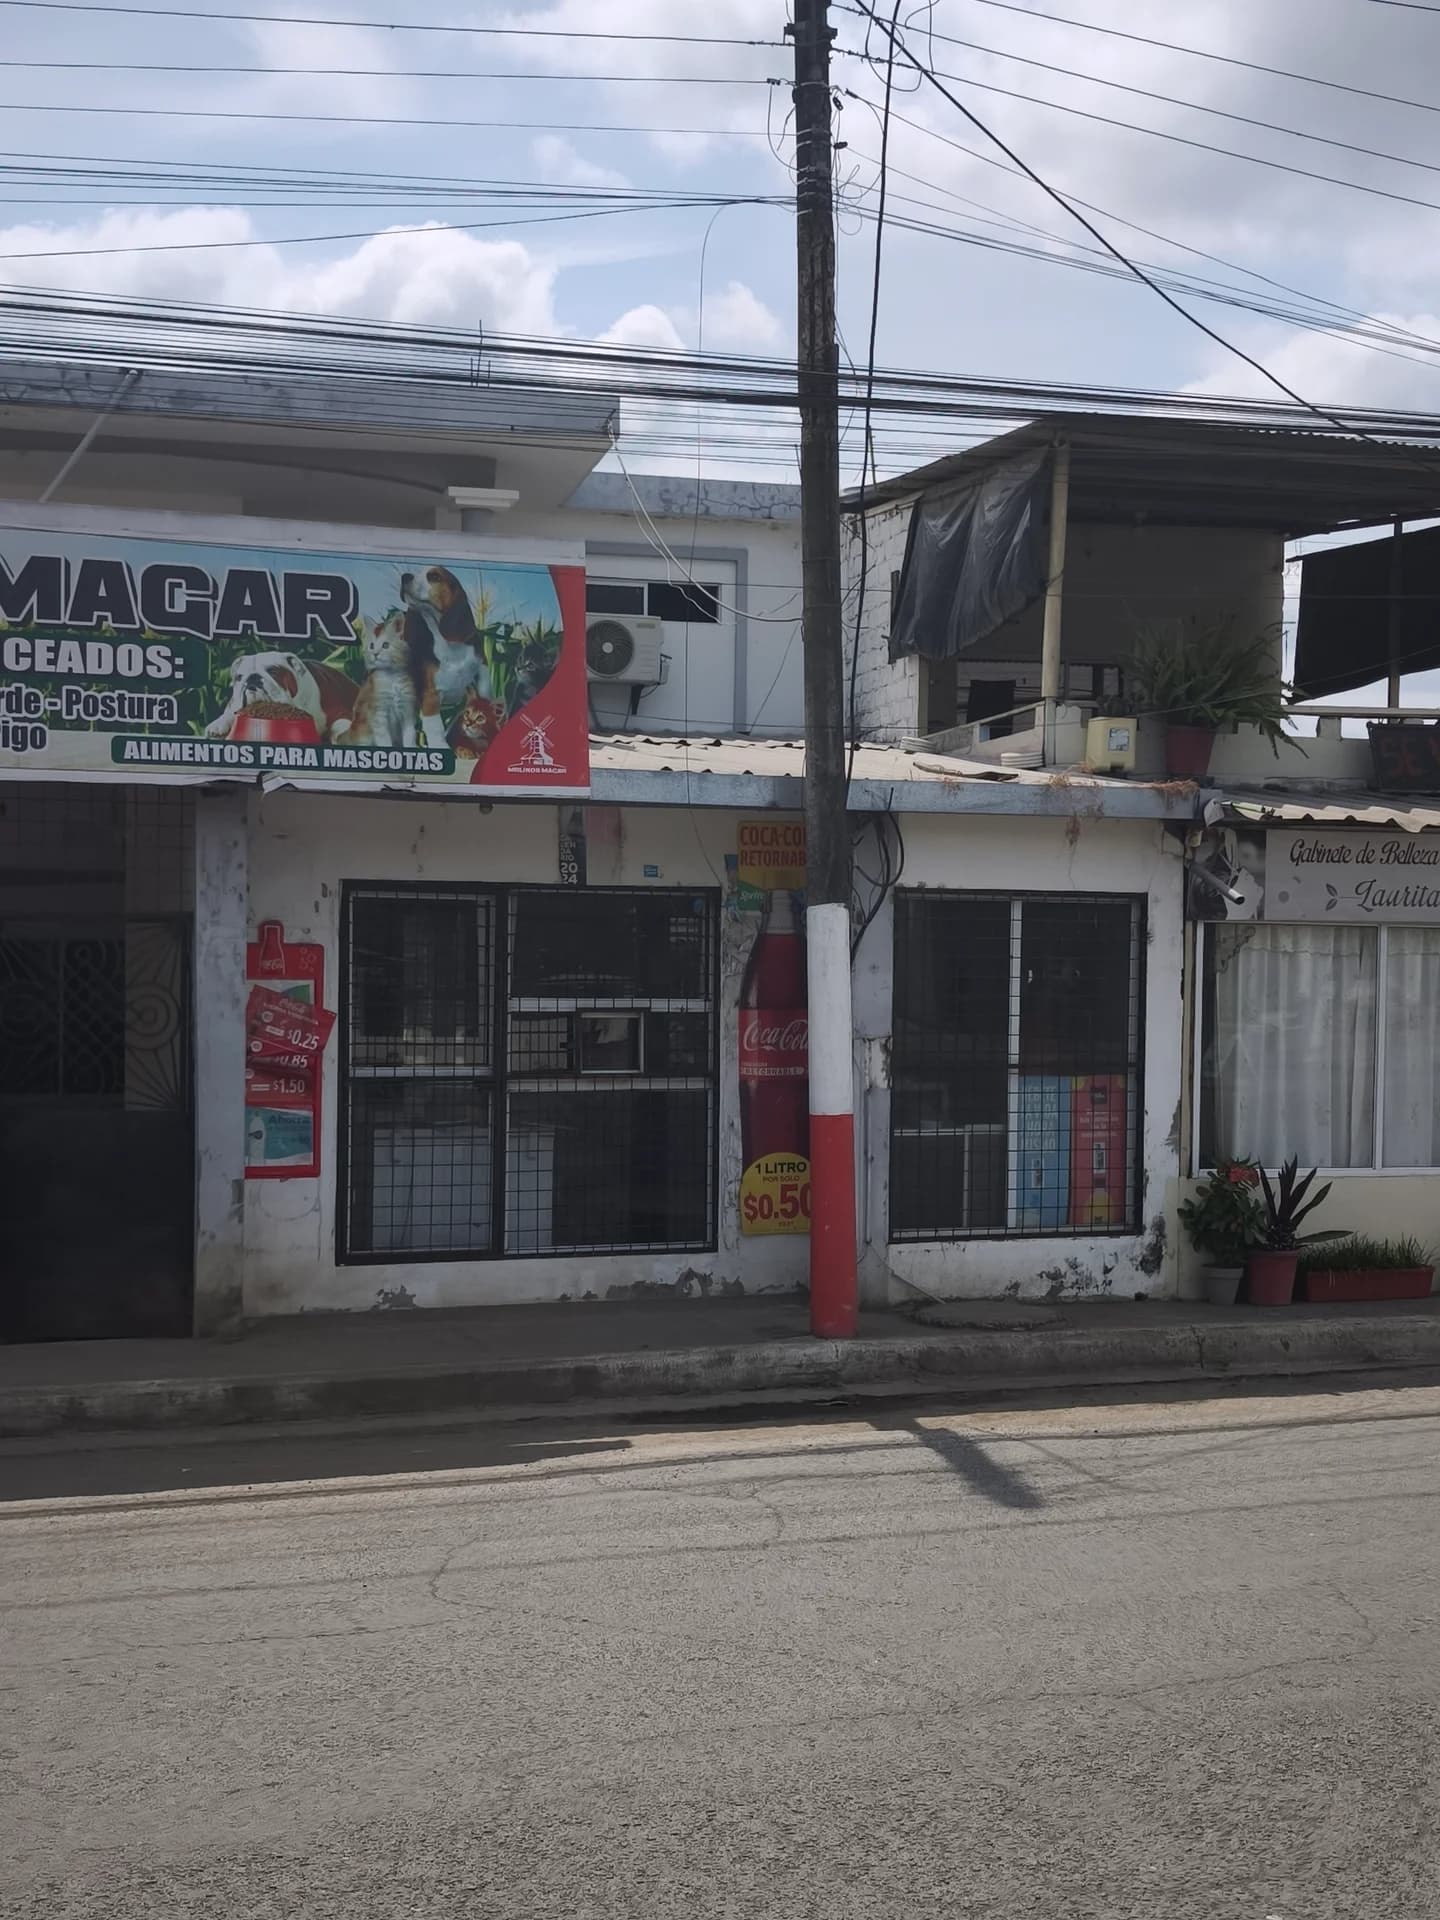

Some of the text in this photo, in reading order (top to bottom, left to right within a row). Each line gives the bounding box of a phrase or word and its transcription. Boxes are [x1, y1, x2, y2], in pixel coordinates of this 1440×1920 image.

[0, 554, 358, 642] MAGAR
[3, 637, 184, 679] CEADOS:
[123, 740, 444, 771] ALIMENTOS PARA MASCOTAS
[1289, 838, 1440, 867] Gabinete de Belleza
[1354, 879, 1440, 913] Laurita
[287, 1029, 319, 1050] $0.25
[273, 1079, 305, 1094] $1.50
[754, 1161, 807, 1175] 1 LITRO
